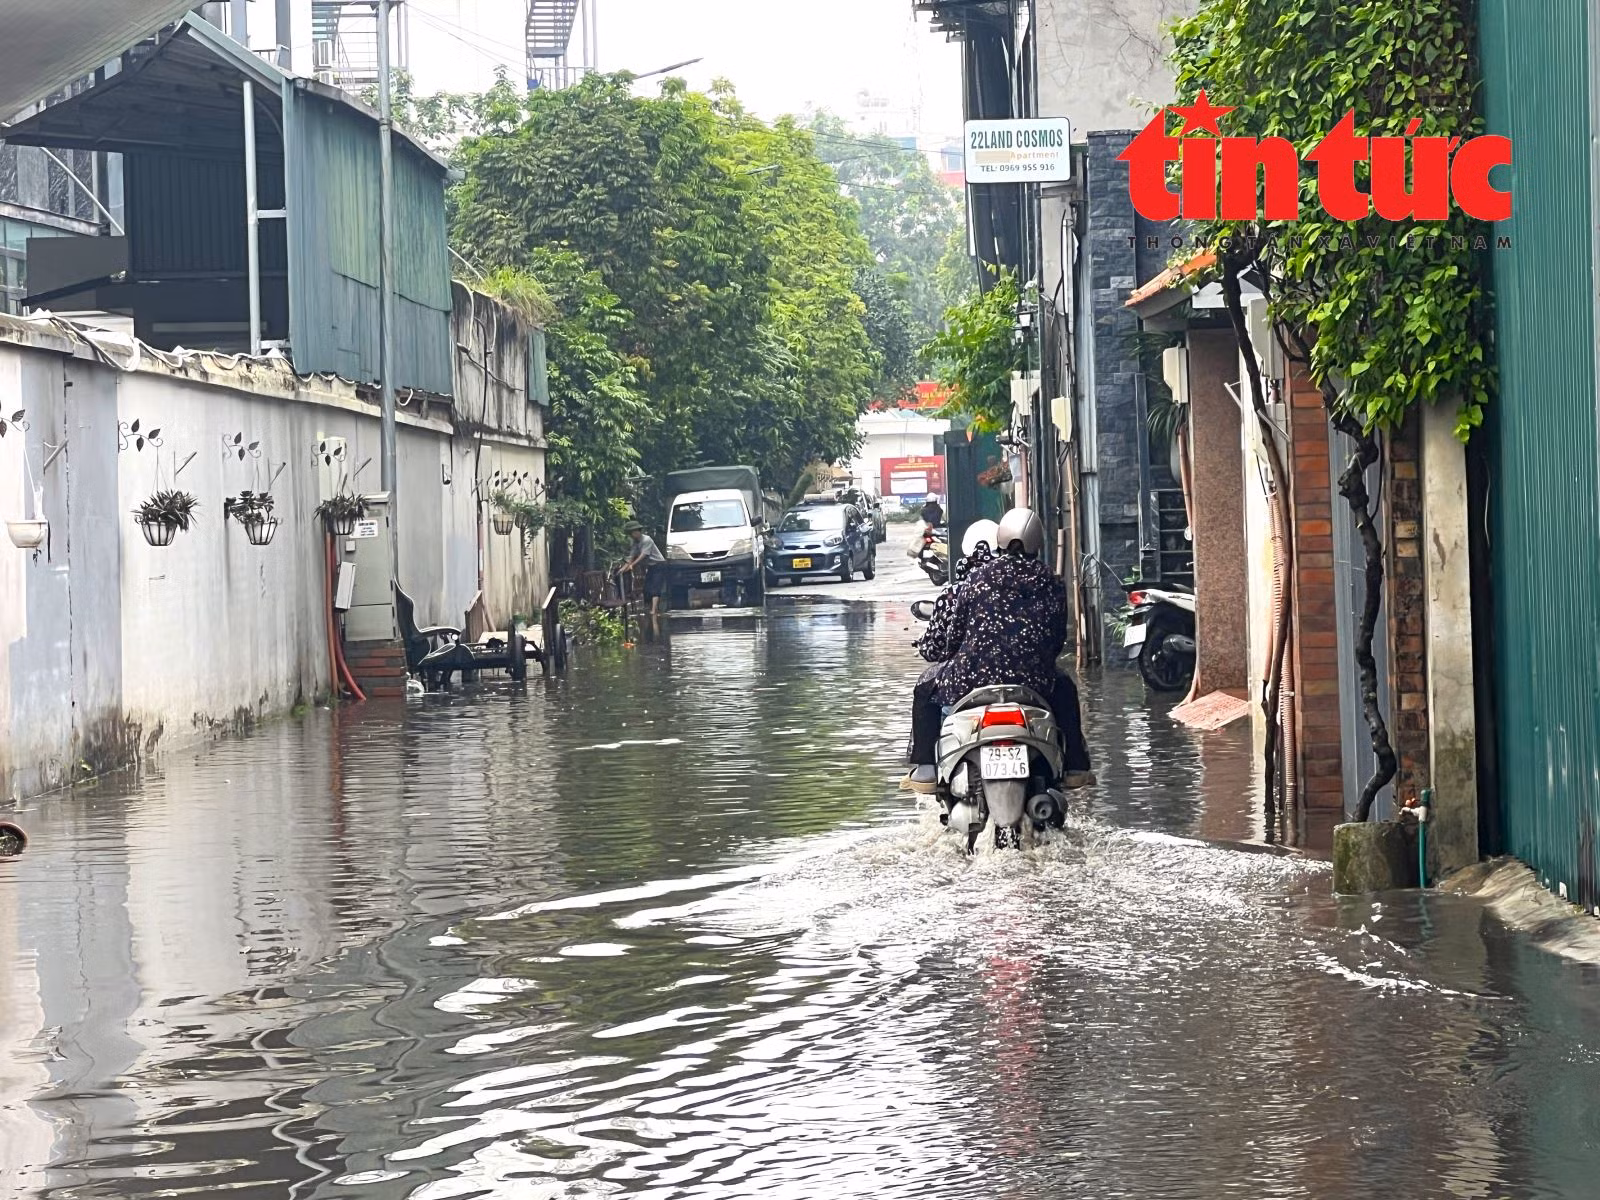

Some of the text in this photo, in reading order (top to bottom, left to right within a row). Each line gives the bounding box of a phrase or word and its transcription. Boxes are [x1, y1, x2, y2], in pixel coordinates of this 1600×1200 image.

[971, 129, 1063, 149] 22LAND COSMOS
[1010, 151, 1059, 160] Apartment
[999, 164, 1020, 172] 0969
[1039, 163, 1055, 171] 916
